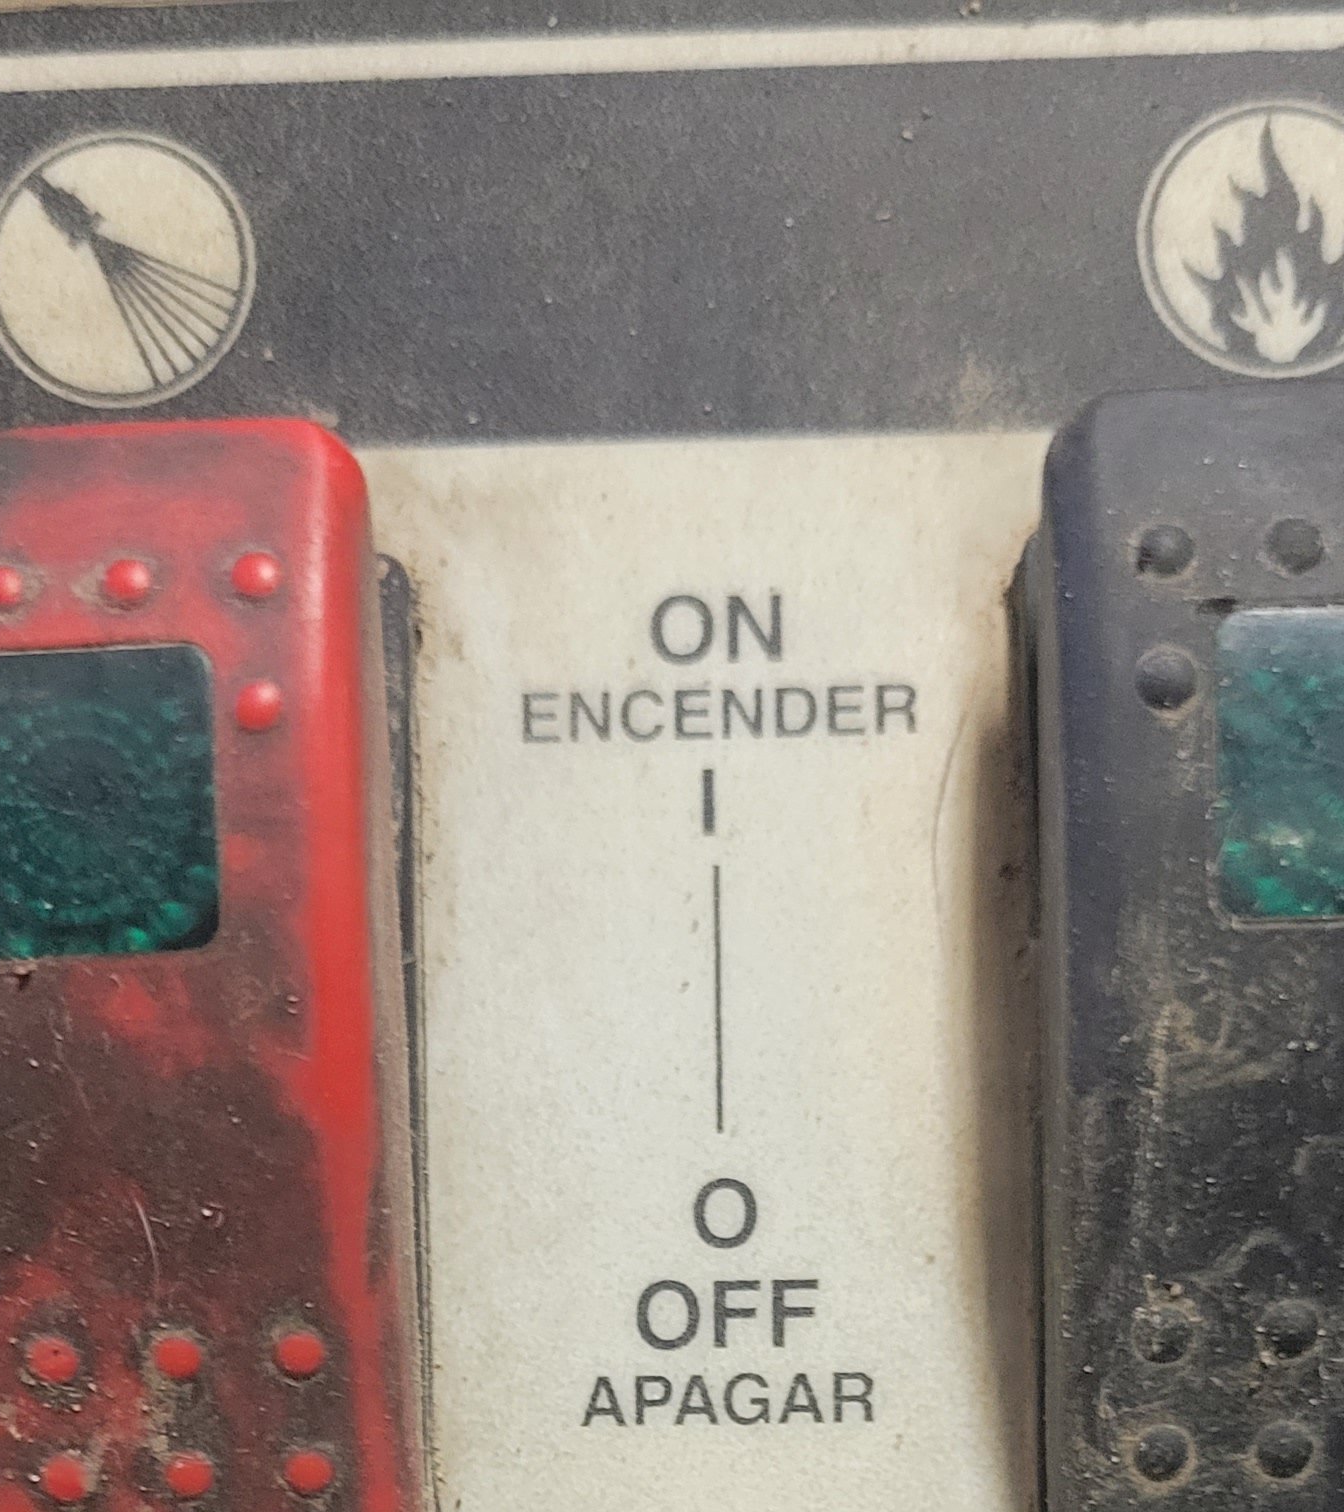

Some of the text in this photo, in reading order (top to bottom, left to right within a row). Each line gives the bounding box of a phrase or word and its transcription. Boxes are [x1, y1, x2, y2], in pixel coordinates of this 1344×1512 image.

[651, 595, 785, 666] ON
[521, 684, 919, 743] ENCENDER
[635, 1278, 819, 1350] OFF
[581, 1371, 875, 1427] APAGAR
